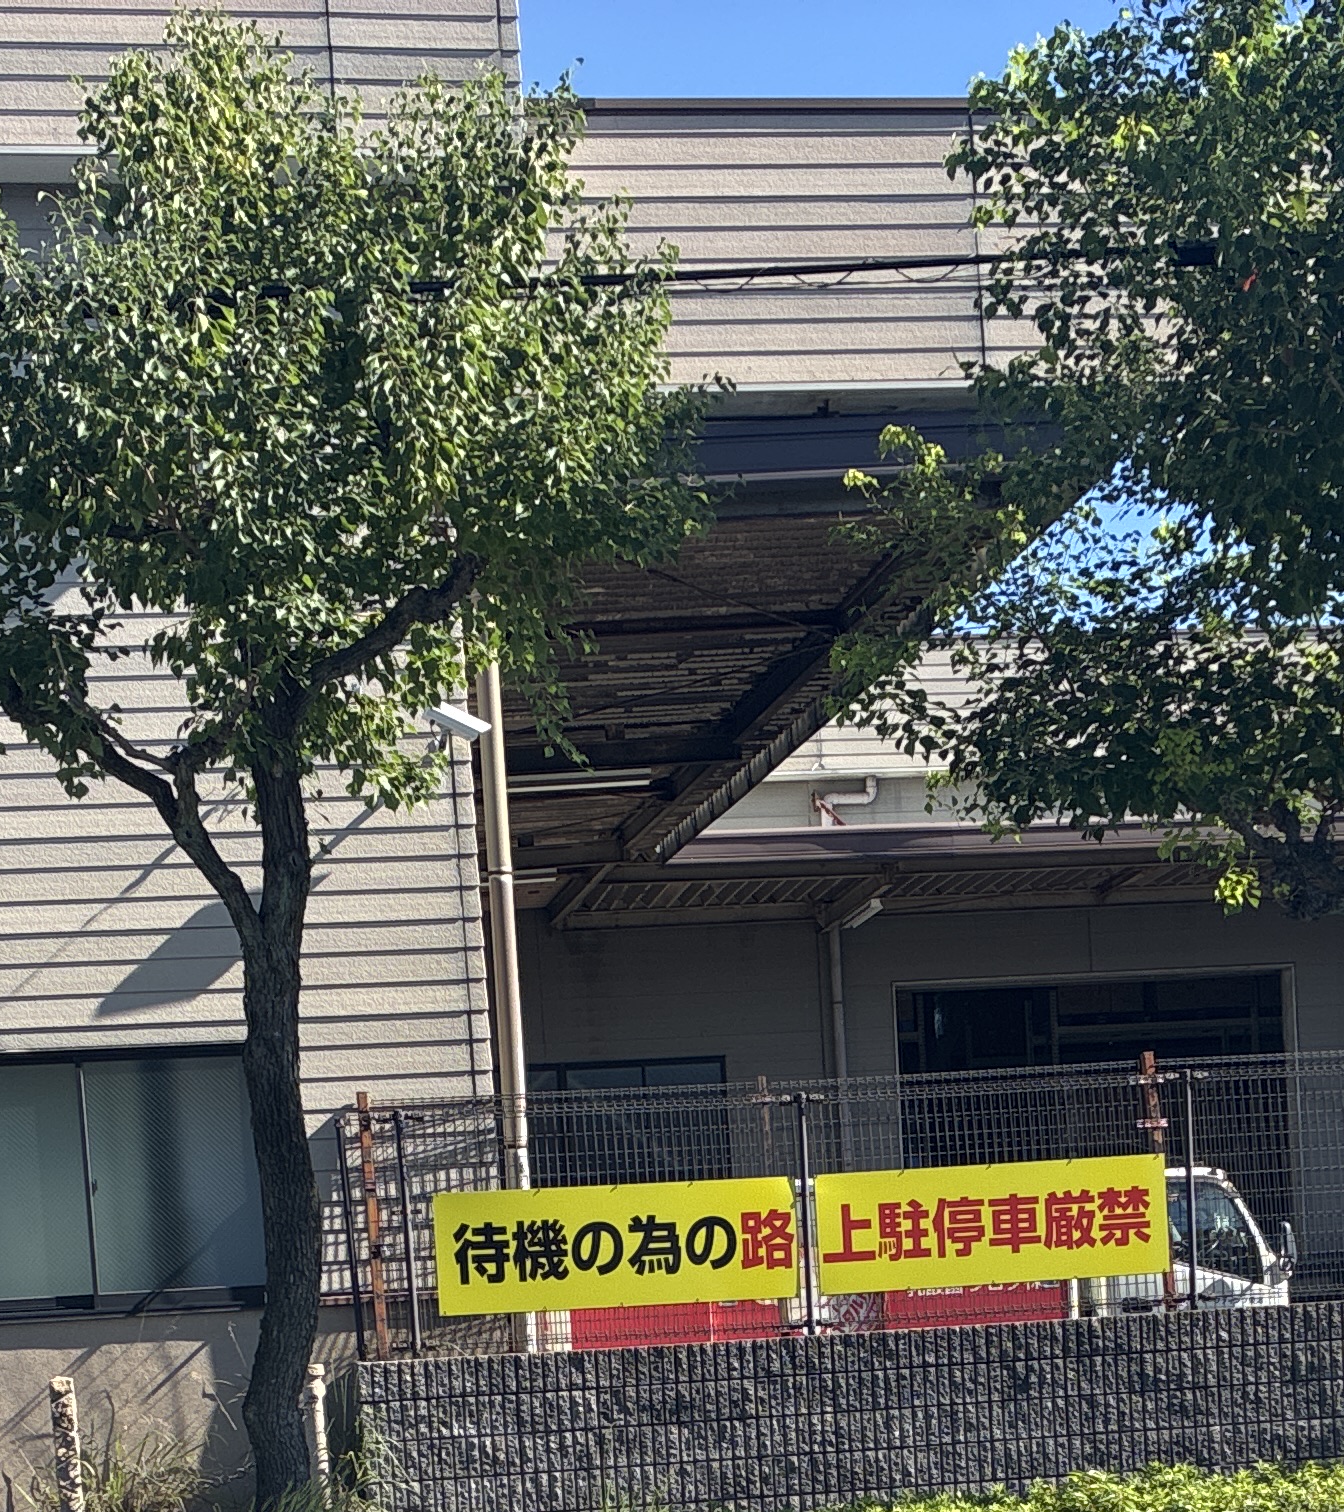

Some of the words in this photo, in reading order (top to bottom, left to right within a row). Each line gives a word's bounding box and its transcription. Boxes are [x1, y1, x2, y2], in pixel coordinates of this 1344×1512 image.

[454, 1209, 794, 1285] 待機の為の路
[822, 1186, 1152, 1265] 上駐停車厳禁
